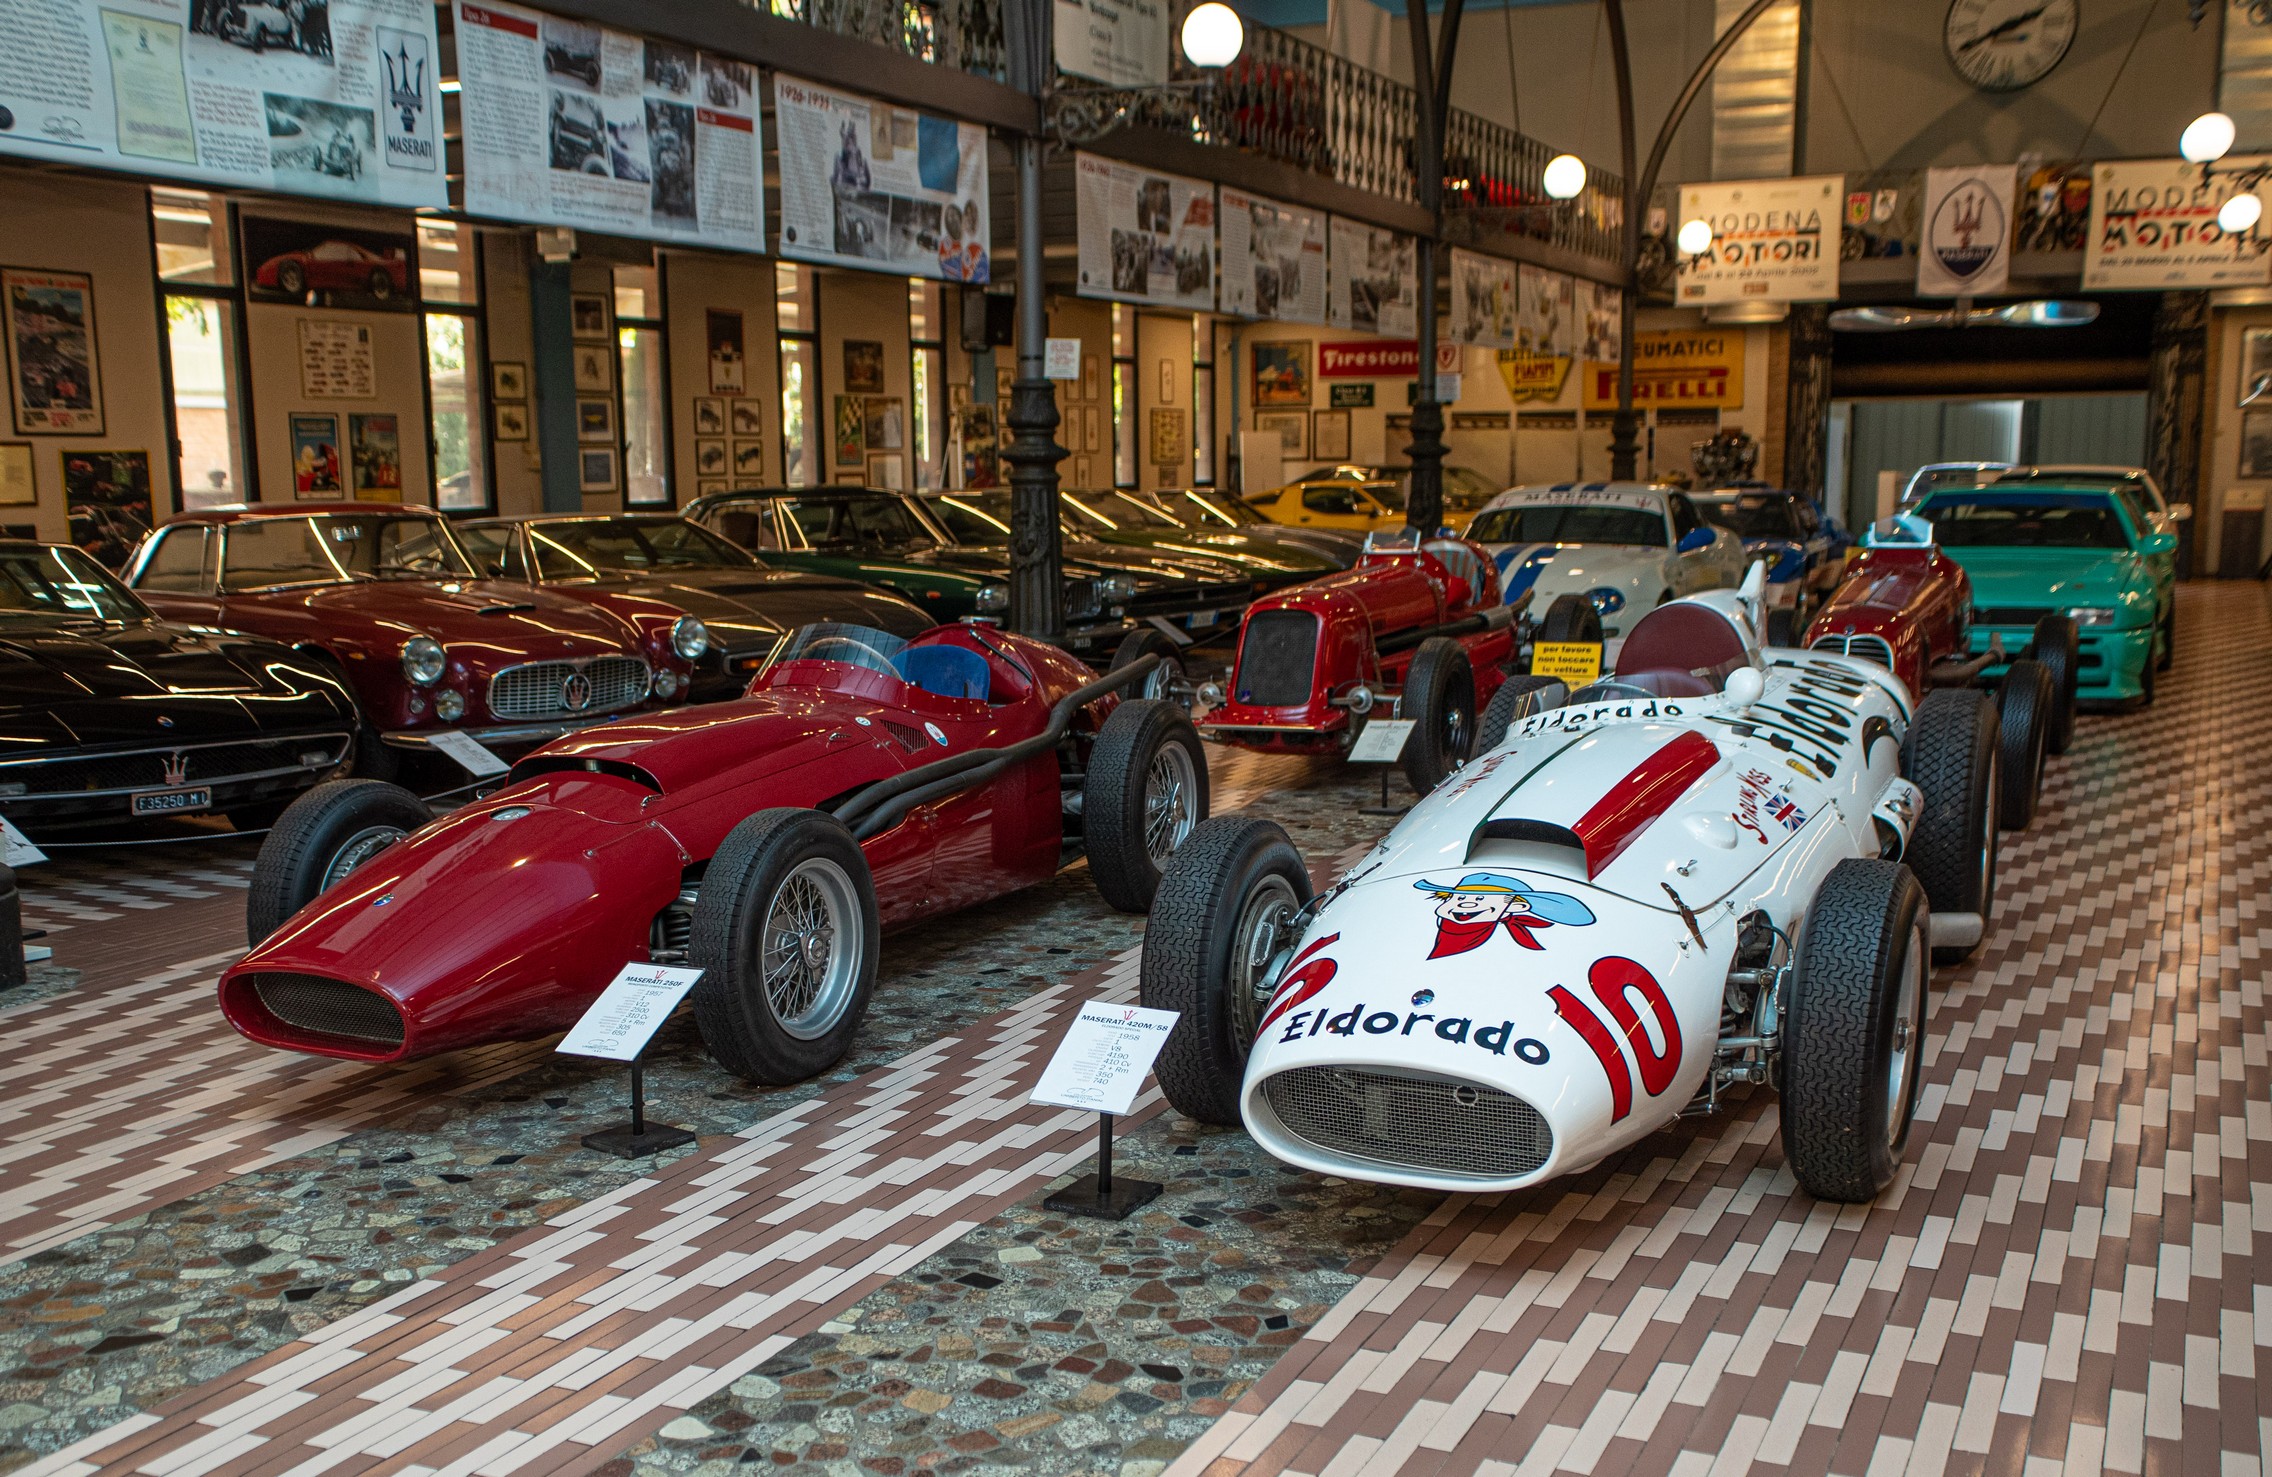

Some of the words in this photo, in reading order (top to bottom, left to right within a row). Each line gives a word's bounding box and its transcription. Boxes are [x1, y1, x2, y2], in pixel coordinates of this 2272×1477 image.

[387, 134, 432, 158] MASERATI
[2106, 186, 2258, 211] MODE
[1699, 208, 1821, 233] MODENA
[2102, 220, 2261, 246] MOTOI
[1324, 349, 1418, 370] Fireston
[1634, 337, 1724, 358] EUMATICI
[1526, 492, 1621, 500] MASERATI
[1522, 700, 1683, 735] Eldorado
[140, 794, 184, 810] F35250
[626, 976, 664, 985] MASERATI
[1082, 1014, 1125, 1026] MASERATI
[1127, 1020, 1168, 1032] 420M/58
[1278, 1004, 1550, 1066] Eldorado
[1544, 956, 1683, 1126] 10
